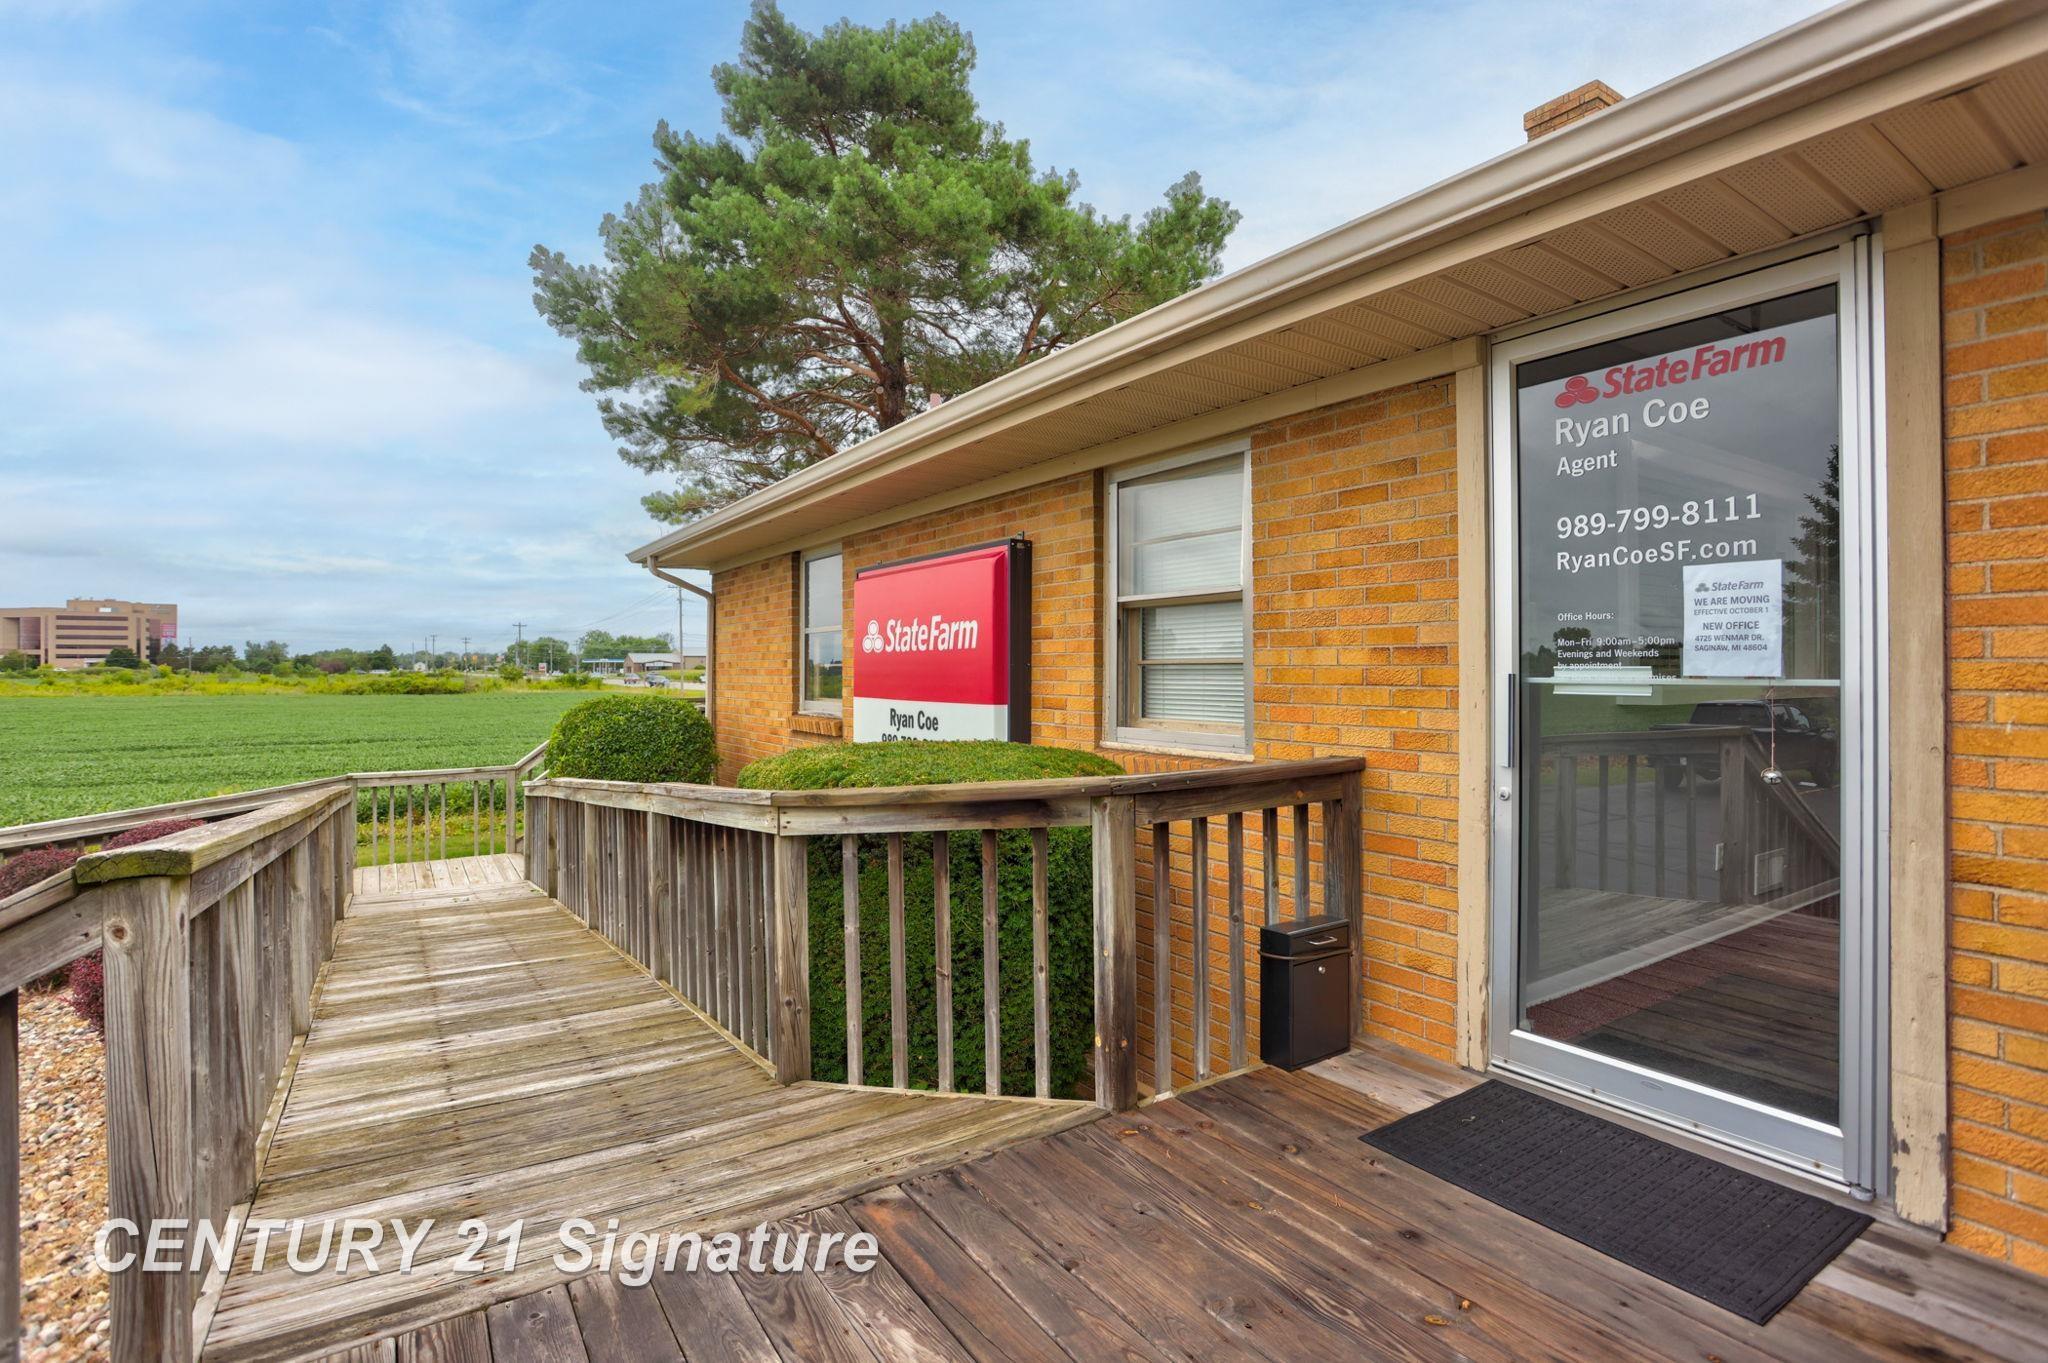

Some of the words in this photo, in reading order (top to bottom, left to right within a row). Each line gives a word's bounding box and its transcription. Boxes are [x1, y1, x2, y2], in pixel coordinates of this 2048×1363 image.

[1602, 336, 1787, 399] StateFarm
[1555, 411, 1630, 448] Ryan
[1642, 396, 1711, 429] Coe
[1556, 448, 1618, 477] Agent
[1556, 493, 1762, 540] 989-799-8111
[1556, 538, 1758, 574] RyanCoeSF.com
[1711, 580, 1764, 591] StateFarm
[1694, 597, 1708, 606] WE
[1710, 597, 1728, 605] ARE
[1730, 595, 1770, 604] MOVING
[1557, 612, 1583, 622] Office
[1585, 611, 1615, 621] Hours:
[1702, 622, 1723, 630] NEW
[1725, 621, 1760, 630] OFFICE
[885, 614, 979, 653] StateFarm
[1557, 649, 1593, 659] Evenings
[1595, 649, 1612, 658] and
[1614, 648, 1660, 658] Weekends
[1694, 644, 1730, 652] SAGINAW,
[889, 707, 914, 731] Ryan
[917, 710, 939, 731] Coe
